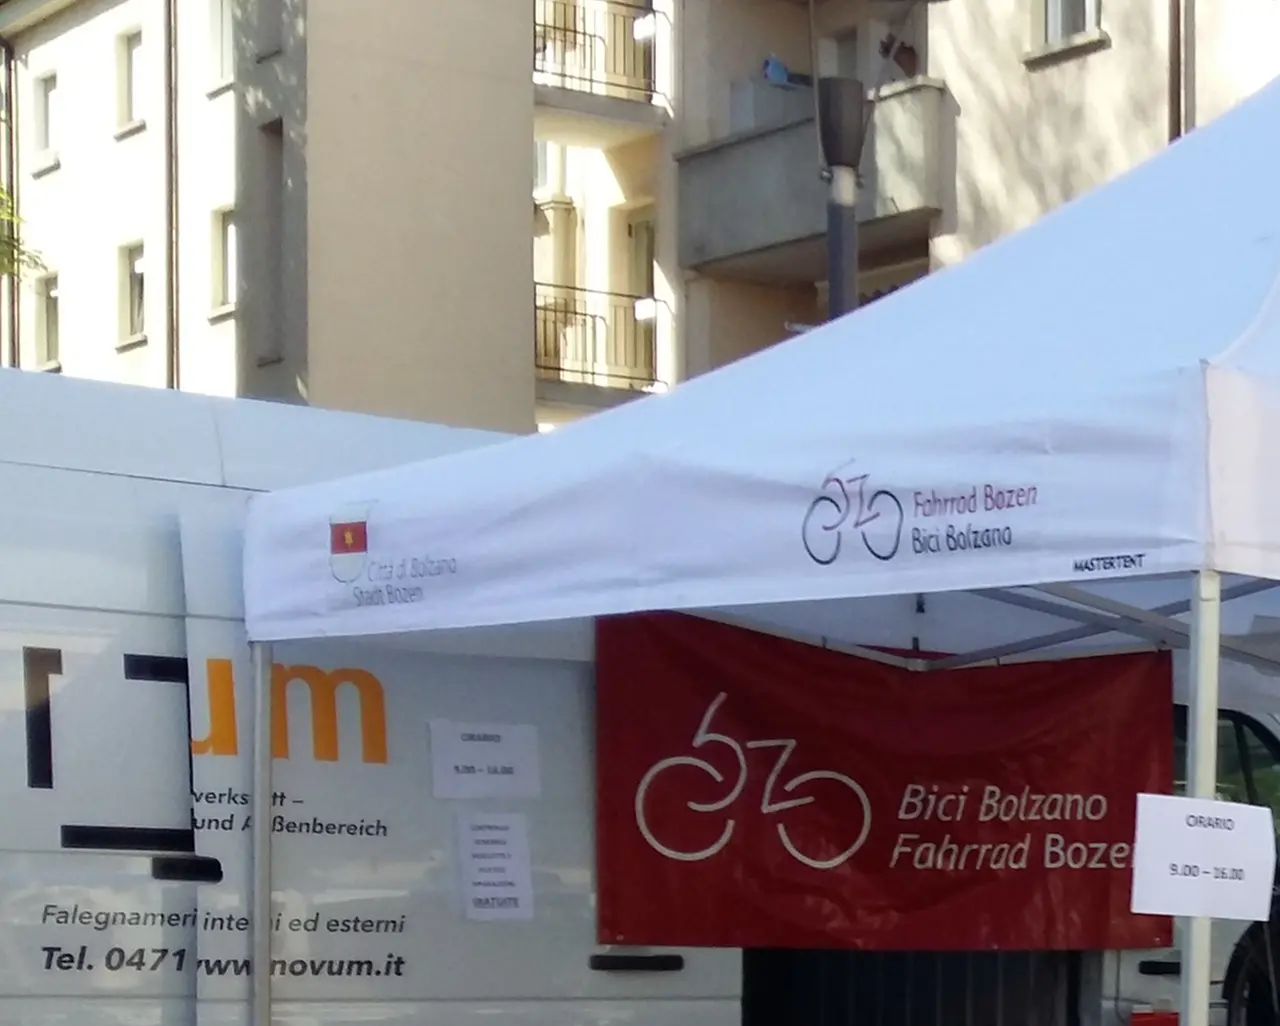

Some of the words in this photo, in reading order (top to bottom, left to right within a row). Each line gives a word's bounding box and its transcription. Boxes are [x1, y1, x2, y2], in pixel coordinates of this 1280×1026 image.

[913, 489, 977, 517] Fahrrad
[984, 484, 1037, 511] Bozen
[912, 526, 940, 554] Bici
[945, 525, 1012, 552] Bolzano
[1072, 553, 1146, 573] MASTERTENT
[353, 585, 385, 607] Stadt
[385, 583, 424, 605] Bozen
[897, 784, 969, 822] Bici
[978, 784, 1108, 823] Bolzano
[194, 814, 235, 832] und
[1185, 814, 1236, 831] ORARIO
[889, 832, 1032, 871] Fahrrad
[1043, 834, 1136, 869] Boze
[1168, 863, 1200, 878] 9.00
[41, 903, 198, 931] Falegnameri
[288, 912, 320, 932] ed
[326, 915, 406, 933] esterni
[41, 946, 94, 971] Tel.
[104, 947, 187, 972] 0471
